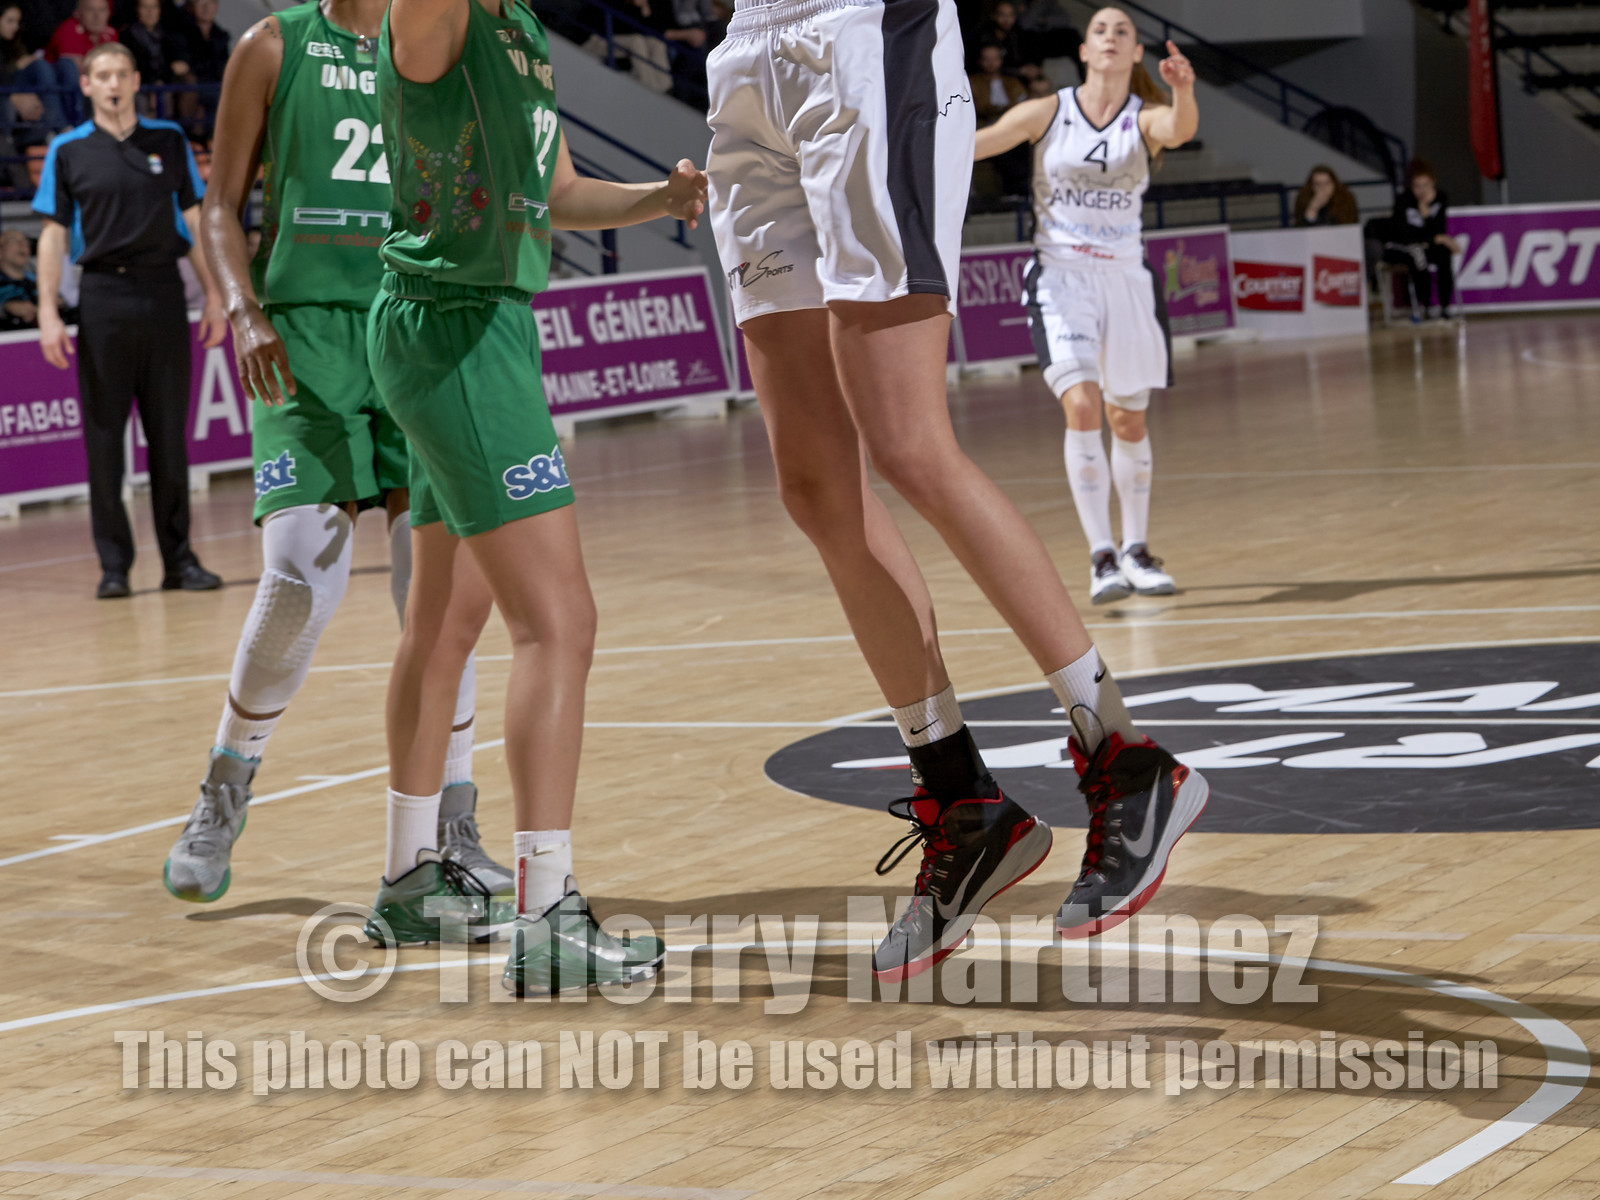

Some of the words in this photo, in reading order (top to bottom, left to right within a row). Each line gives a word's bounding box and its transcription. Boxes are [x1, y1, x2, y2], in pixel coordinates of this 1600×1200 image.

[532, 106, 558, 178] 12
[1083, 140, 1108, 173] 4
[1049, 188, 1132, 210] ANGERS
[961, 257, 1028, 307] ESPAC
[1454, 226, 1600, 290] ART
[587, 286, 706, 344] GÉNÉRAL
[0, 397, 81, 437] FAB49
